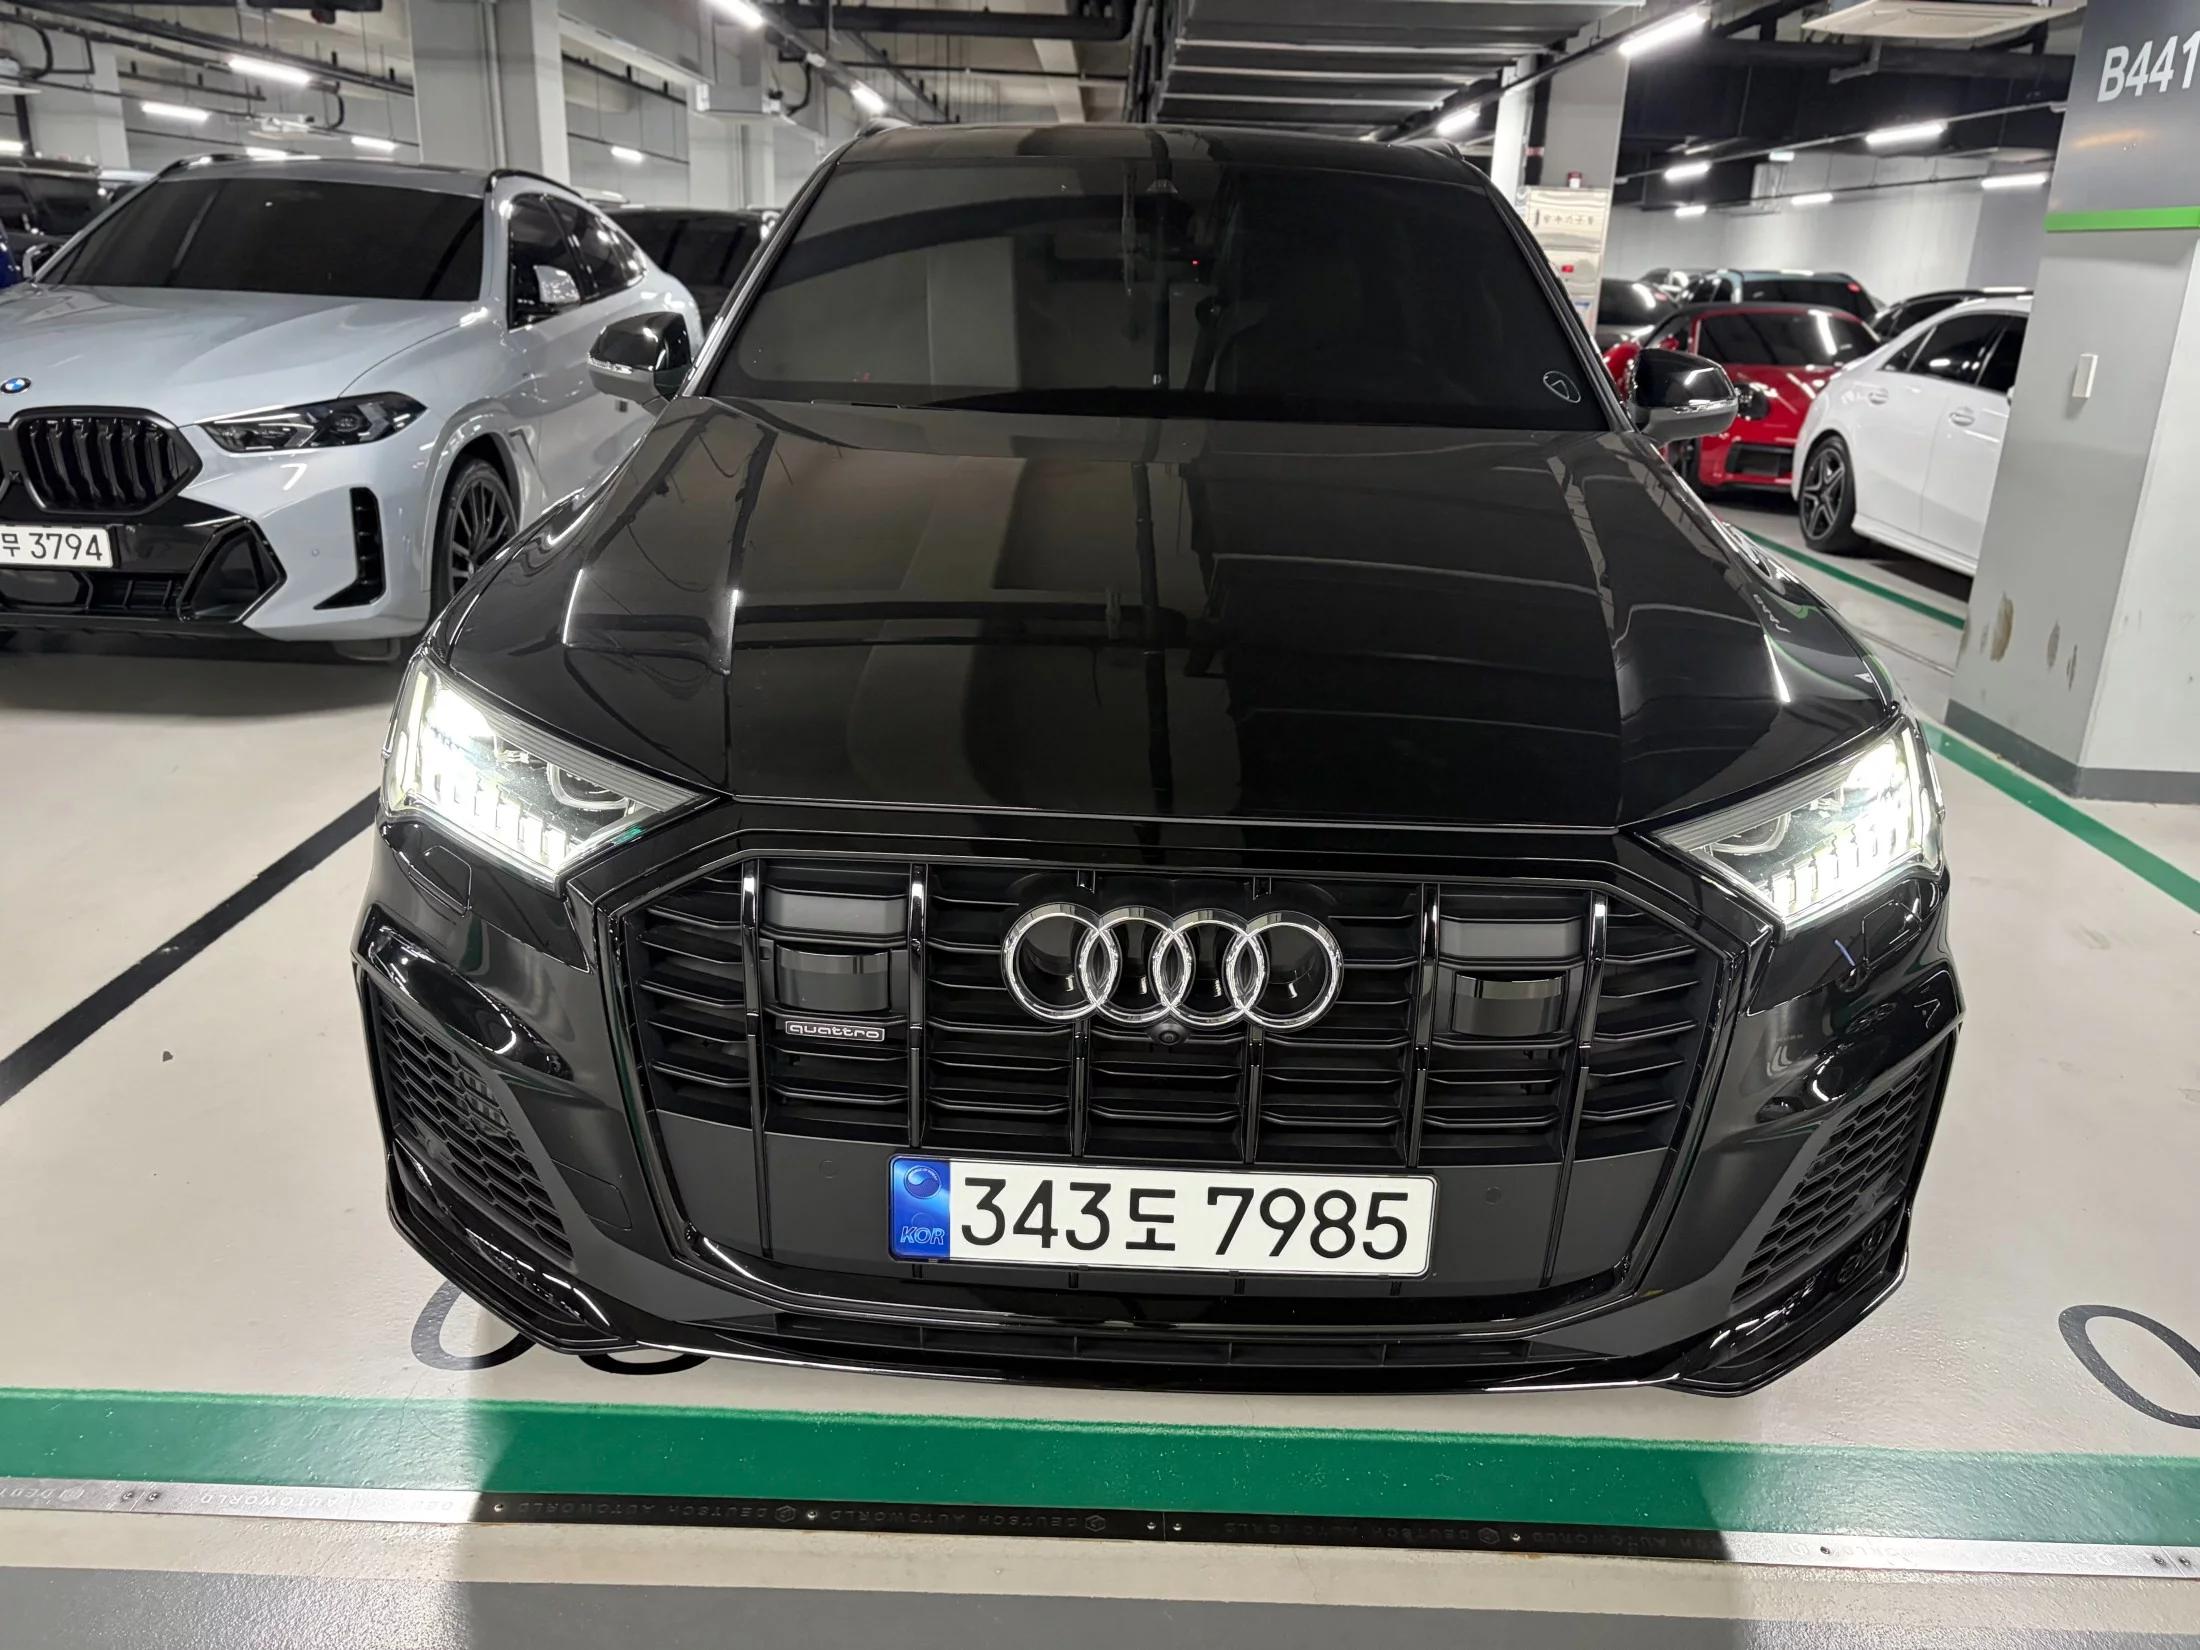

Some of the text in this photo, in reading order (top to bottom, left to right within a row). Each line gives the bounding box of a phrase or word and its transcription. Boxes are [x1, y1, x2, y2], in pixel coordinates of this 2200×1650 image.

[2097, 30, 2200, 102] B441
[1, 533, 103, 561] 무 3794
[789, 1024, 880, 1039] quattro
[961, 1177, 1409, 1260] 343도 7985
[900, 1225, 945, 1245] KOR
[199, 1493, 339, 1508] AUTOWORLD
[517, 1501, 769, 1519] DEUTSCH AUTOWORLD
[829, 1509, 1079, 1529] DEUTSCH AUTOWORLD
